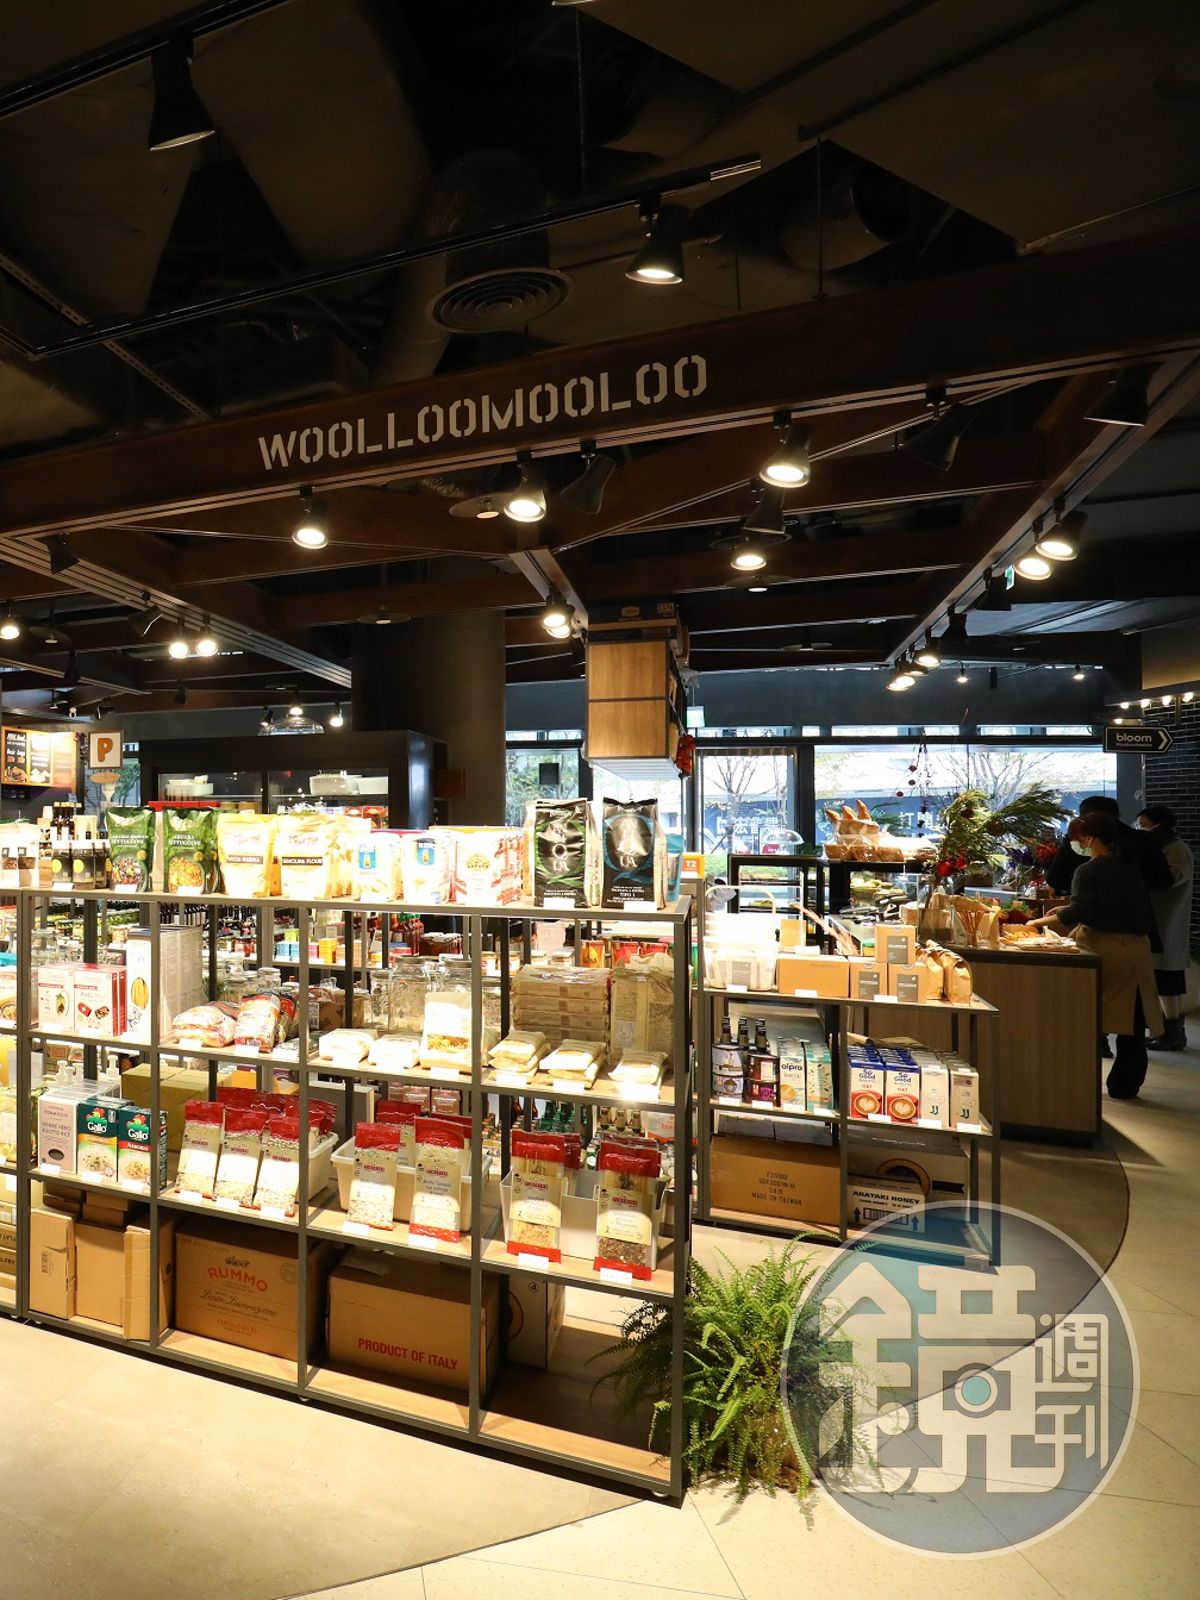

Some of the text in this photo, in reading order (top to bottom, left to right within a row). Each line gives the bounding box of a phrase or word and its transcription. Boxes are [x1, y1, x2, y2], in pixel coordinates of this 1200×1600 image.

[258, 354, 707, 471] WOOLLOOMOOLOO
[1116, 732, 1152, 743] bloom
[97, 737, 113, 763] P
[781, 1062, 803, 1072] alpro
[88, 1122, 107, 1133] Gallo
[128, 1128, 149, 1140] Gallo
[853, 1190, 889, 1201] ARATAKI
[891, 1195, 920, 1205] HONEY
[207, 1266, 268, 1292] RUMMO
[357, 1337, 458, 1370] PRODUCT OF ITALY
